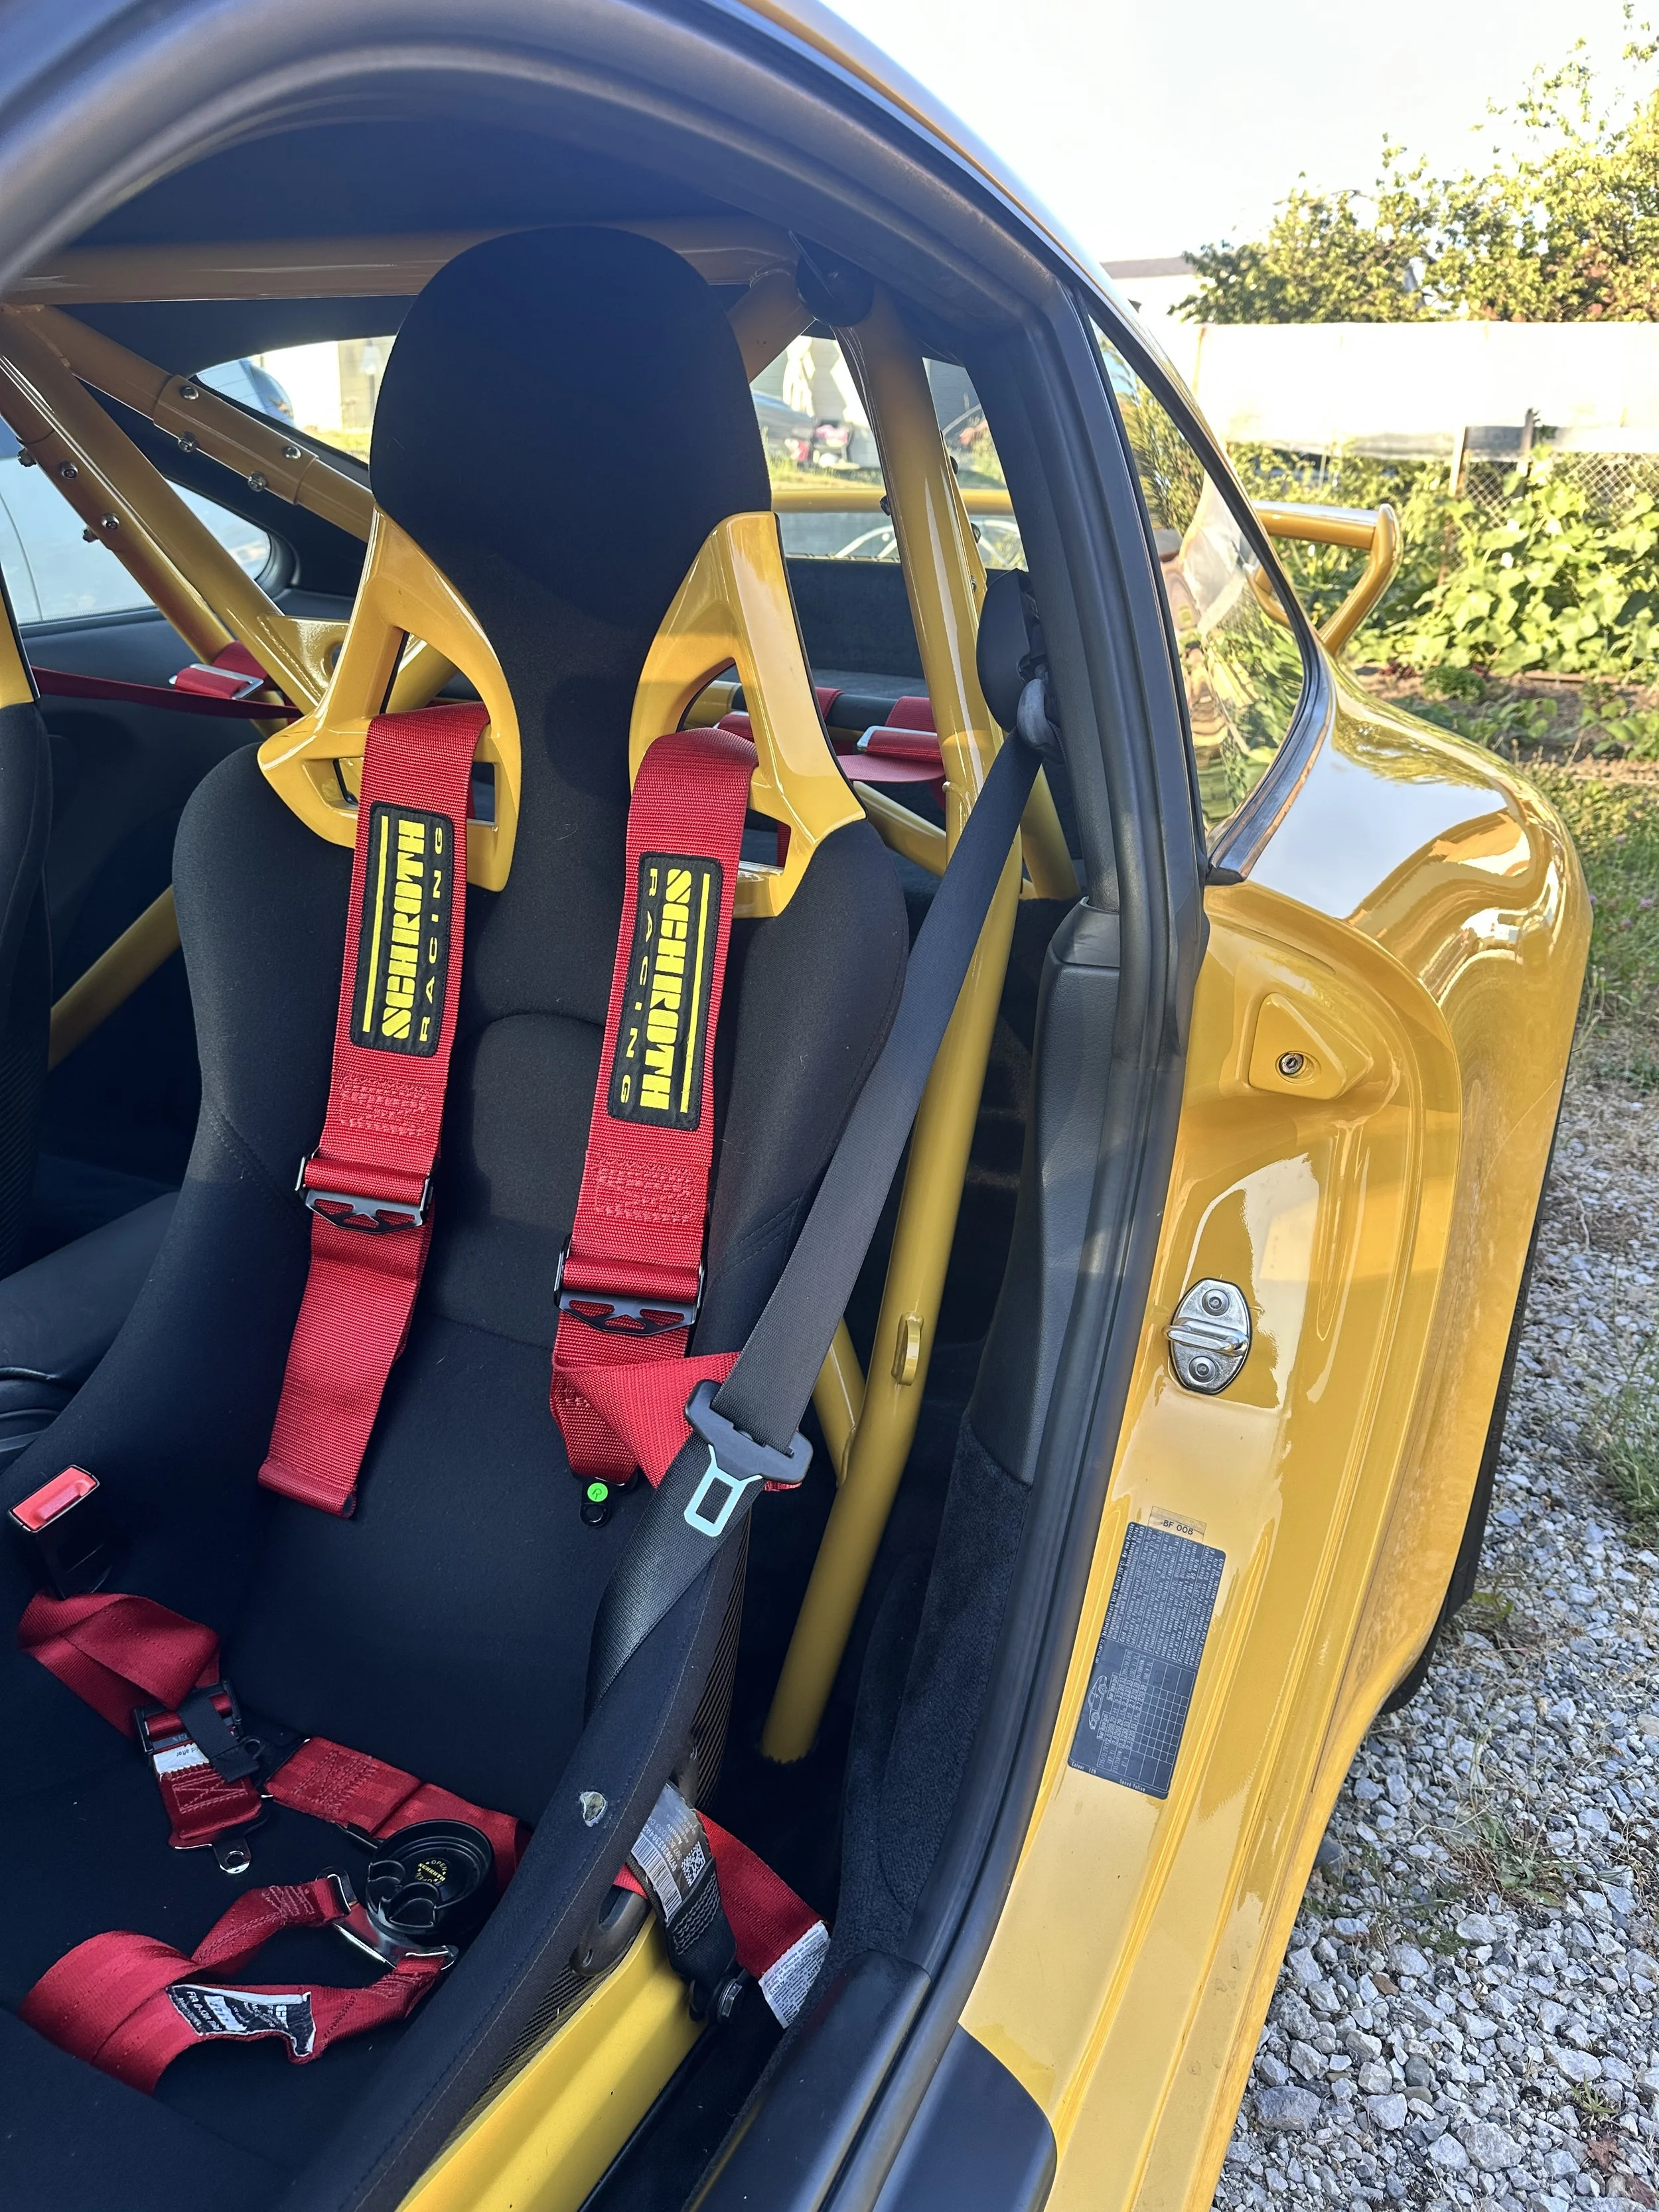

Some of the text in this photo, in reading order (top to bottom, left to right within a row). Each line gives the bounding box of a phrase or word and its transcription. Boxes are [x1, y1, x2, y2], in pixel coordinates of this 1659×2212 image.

[382, 820, 425, 1040] SCHROTH
[419, 827, 443, 1042] RACING
[620, 867, 657, 1104] RACING
[639, 867, 693, 1110] SCHROTH
[1163, 1519, 1194, 1535] BF 008
[1119, 1778, 1131, 1787] Speed
[666, 1824, 682, 1844] Autoliv
[431, 1860, 447, 1870] OPEN
[769, 1979, 785, 1996] ALWAYS
[782, 2003, 794, 2016] NEVER
